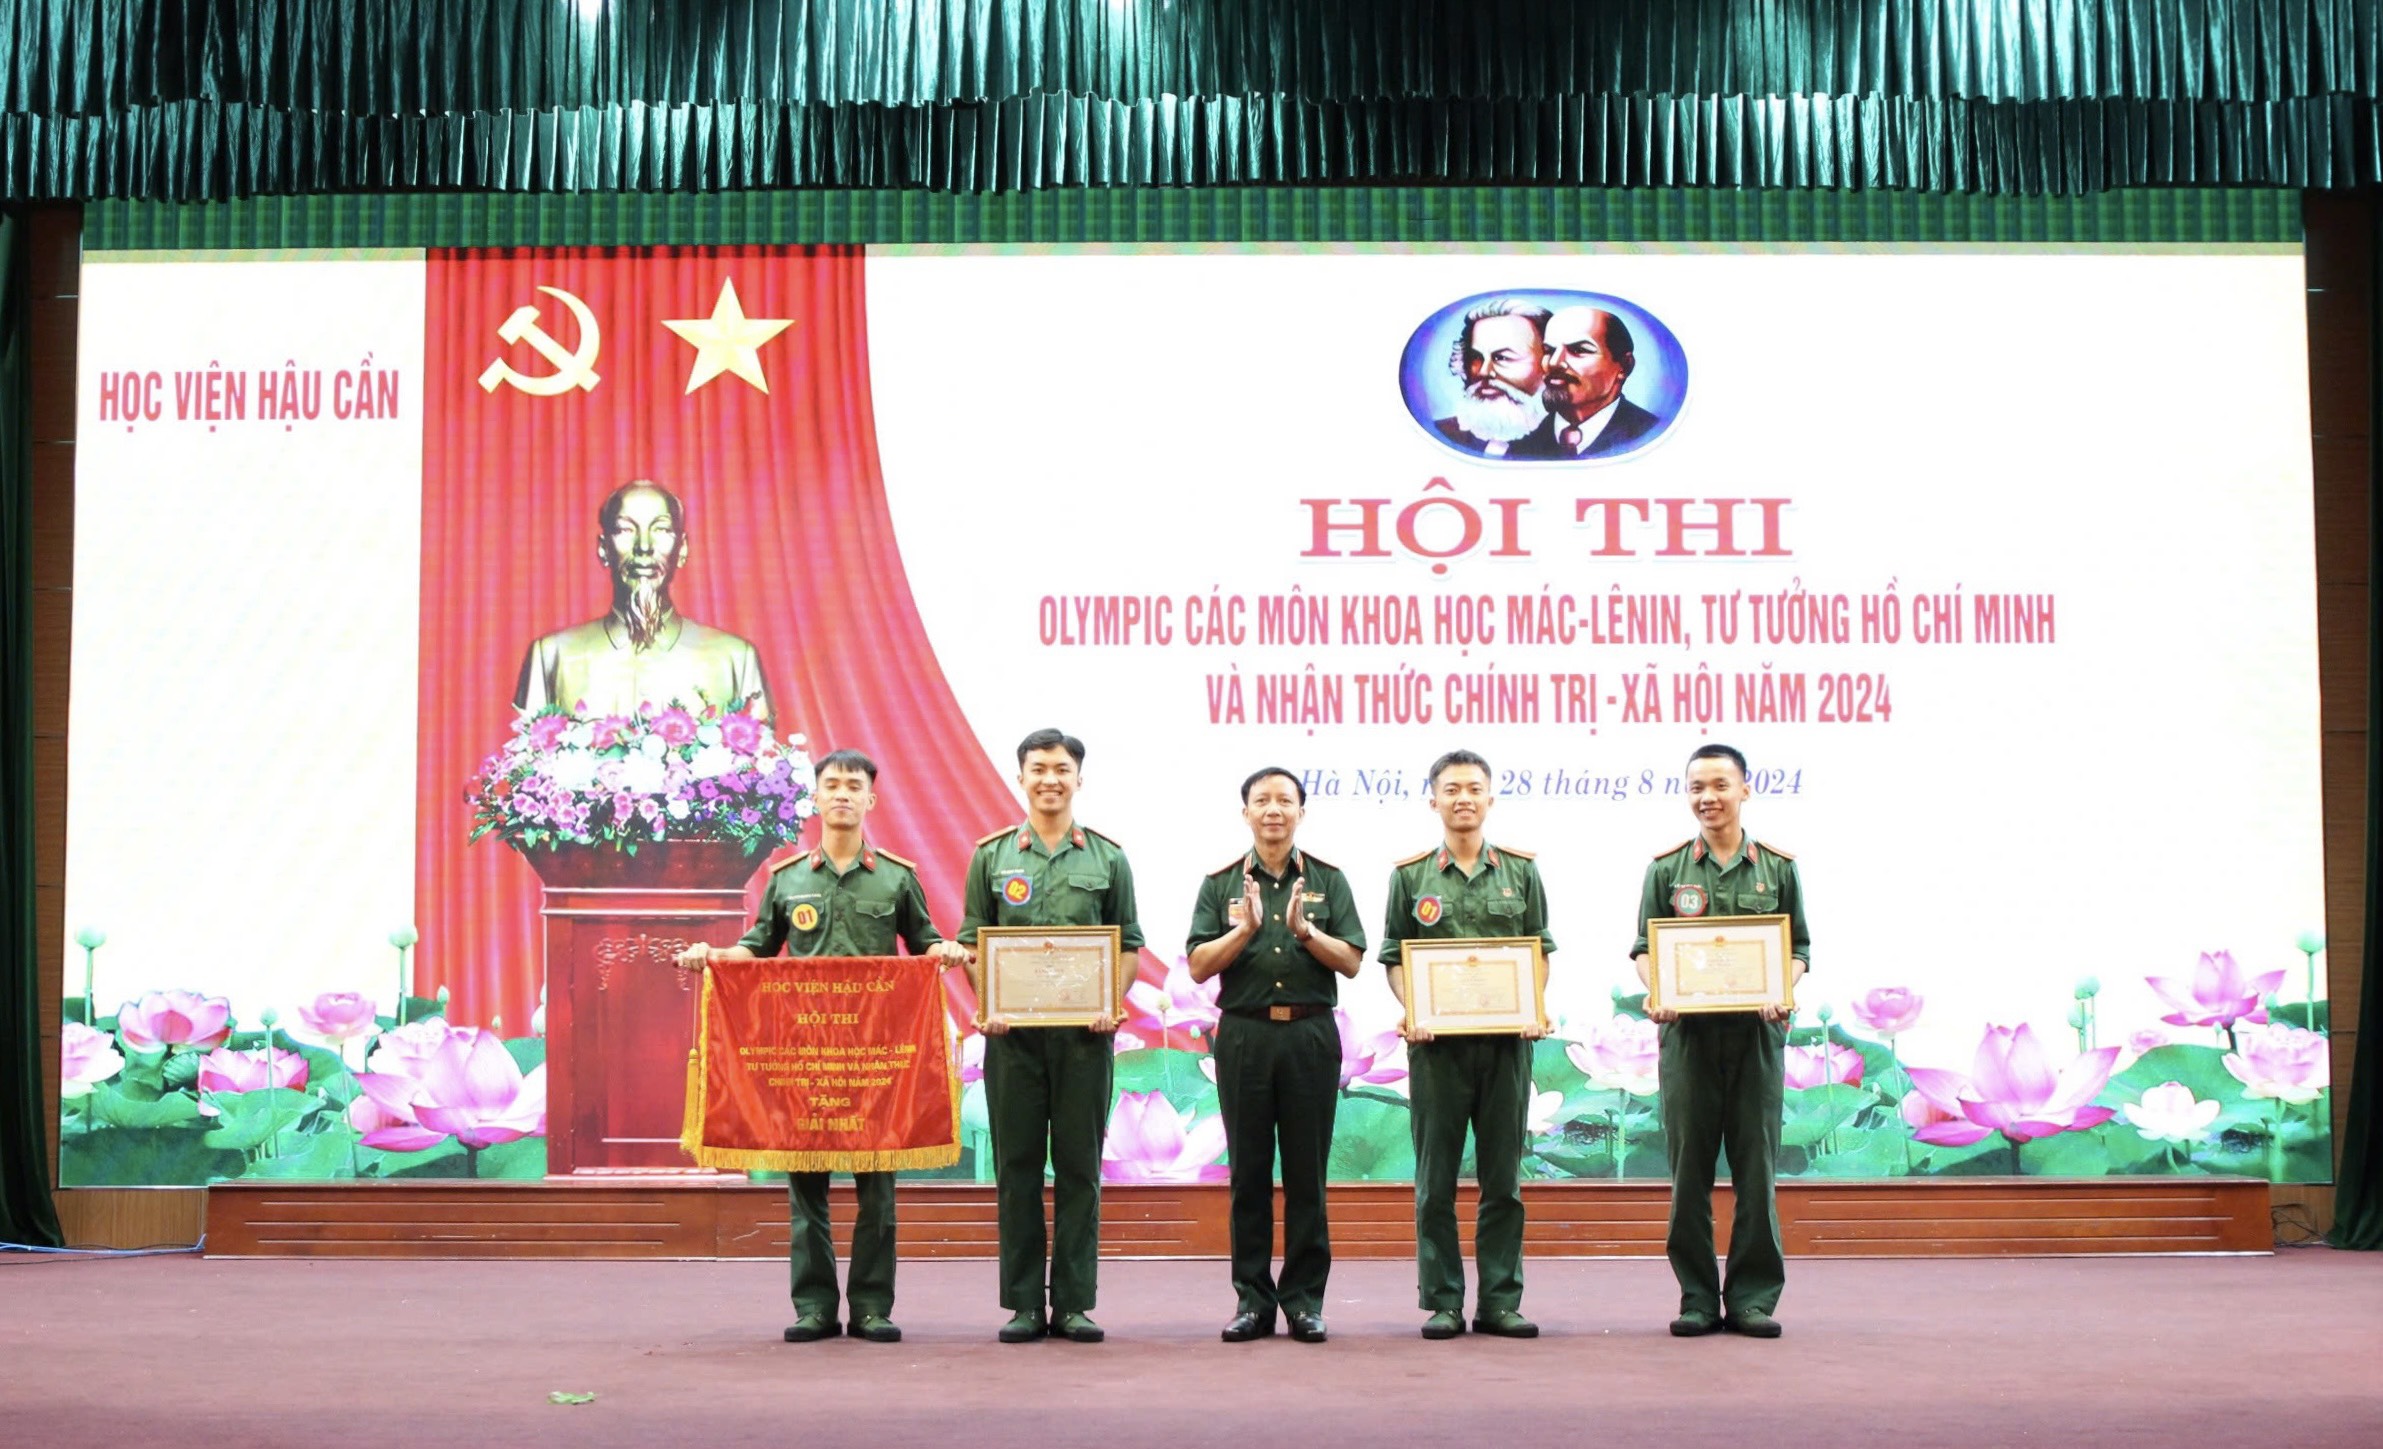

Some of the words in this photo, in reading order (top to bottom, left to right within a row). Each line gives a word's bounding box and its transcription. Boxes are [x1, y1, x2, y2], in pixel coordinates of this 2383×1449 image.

[100, 371, 163, 433] HỌC
[174, 360, 247, 433] VIỆN
[258, 359, 321, 432] HẬU
[333, 351, 399, 420] CẦN
[1300, 476, 1531, 575] HỘI
[1575, 498, 1793, 556] THI
[1039, 595, 1173, 646] OLYMPIC
[1185, 584, 1246, 646] CÁC
[1258, 584, 1329, 646] MÔN
[1341, 594, 1423, 646] KHOA
[1434, 594, 1495, 657] HỌC
[1507, 583, 1691, 651] MÁC-LÊNIN,
[1701, 590, 1741, 645] TƯ
[1748, 577, 1850, 645] TƯỞNG
[1861, 577, 1901, 644] HỒ
[1913, 583, 1962, 644] CHÍ
[1974, 594, 2055, 644] MINH
[1206, 663, 1245, 724] VÀ
[1257, 663, 1343, 737] NHẬN
[1354, 663, 1432, 725] THỨC
[1445, 663, 1539, 724] CHÍNH
[1550, 673, 1597, 735] TRỊ
[1673, 662, 1723, 735] HỘI
[1735, 663, 1806, 723] NĂM
[1818, 673, 1892, 723] 2024
[1302, 769, 1340, 796] Hà
[1353, 768, 1409, 804] Nội,
[1500, 769, 1533, 796] 28
[1544, 768, 1630, 801] tháng
[1638, 768, 1655, 796] 8
[1007, 880, 1027, 900] 02
[1680, 893, 1699, 909] 03
[797, 909, 814, 925] 01
[1420, 900, 1438, 920] 01
[797, 1010, 827, 1028] HỘI
[830, 1012, 859, 1025] THI
